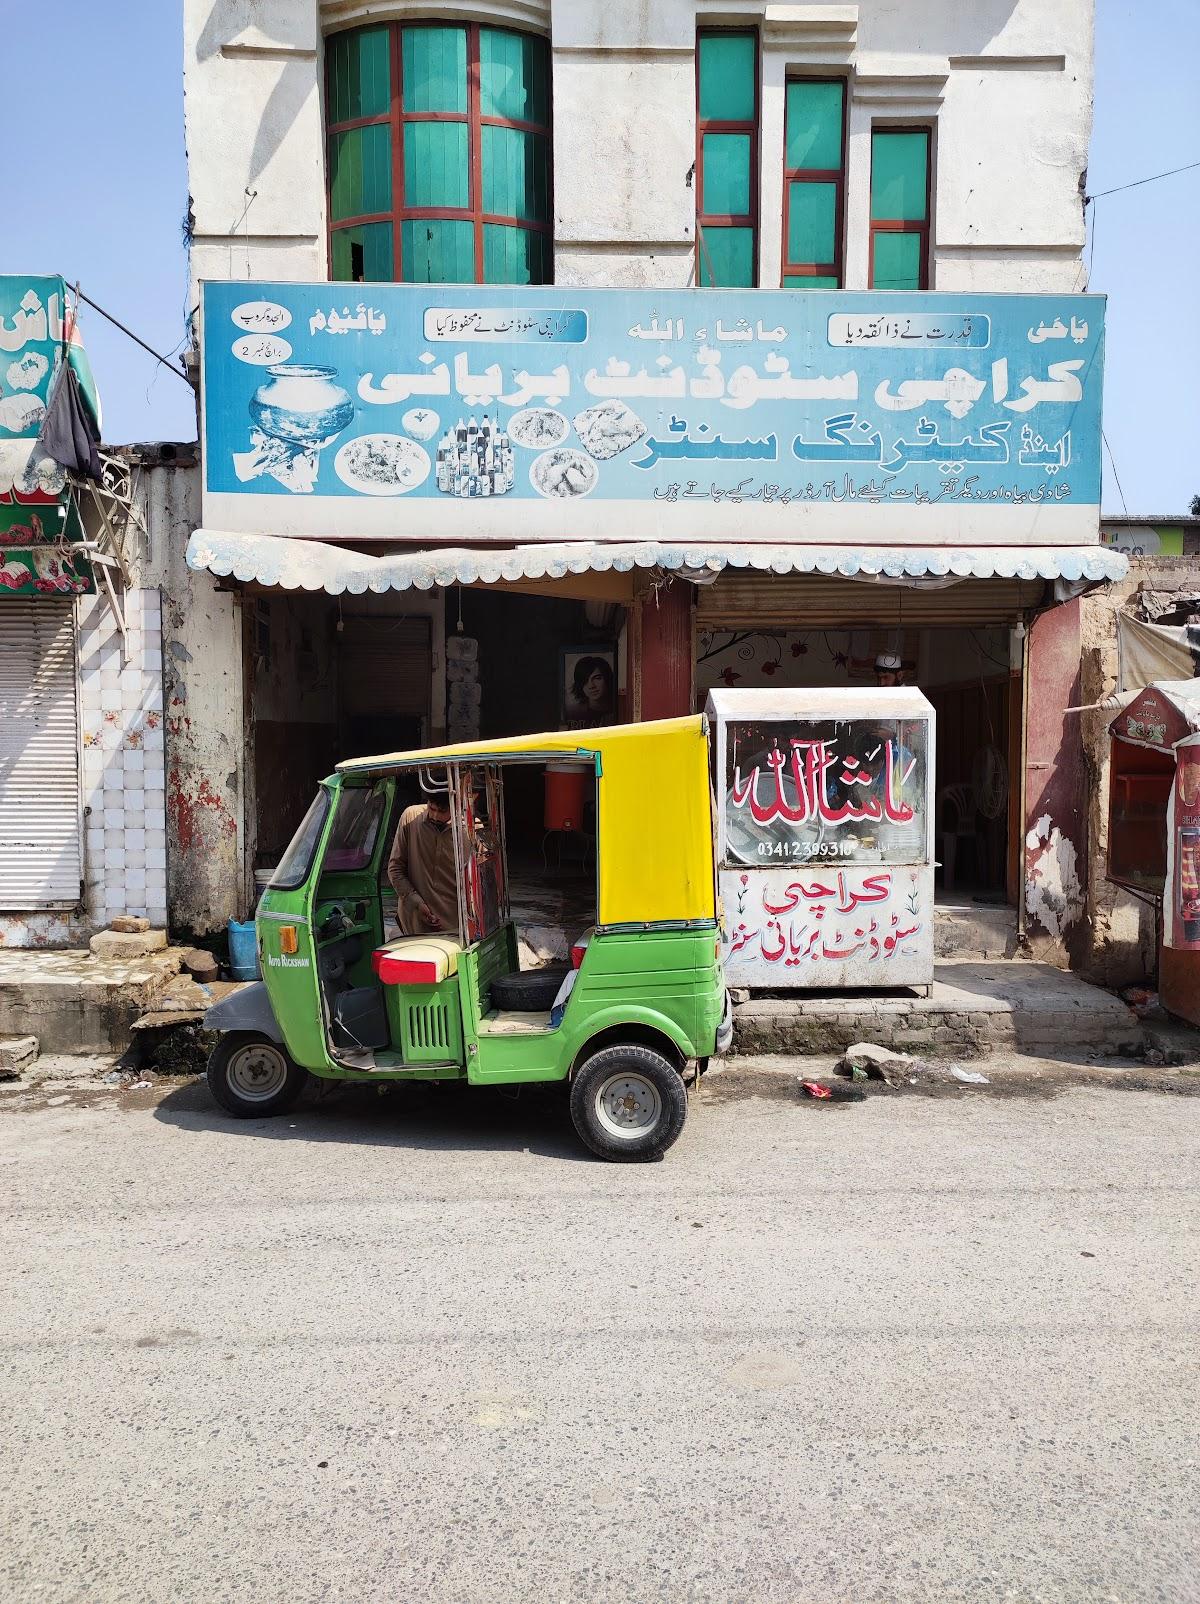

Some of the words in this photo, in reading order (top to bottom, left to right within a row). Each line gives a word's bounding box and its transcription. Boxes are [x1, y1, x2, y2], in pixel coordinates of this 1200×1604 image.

[240, 307, 272, 325] گروپ
[436, 313, 453, 336] کیا
[449, 313, 478, 332] محفوظ
[474, 316, 491, 332] نے
[494, 317, 539, 332] سٹوڈنٹ
[538, 312, 576, 339] کراچی
[845, 322, 862, 344] دیا
[900, 319, 923, 339] نے
[926, 317, 973, 341] قدرت
[242, 346, 249, 356] 2
[251, 342, 265, 358] نمبر
[264, 342, 282, 358] برانچ
[357, 351, 570, 407] بریانی
[584, 343, 858, 410] سٹوڈنٹ
[874, 357, 1086, 419] کراچی
[628, 414, 778, 471] سنٹر
[791, 411, 1012, 475] کیٹرنگ
[1018, 422, 1071, 476] اینڈ
[653, 482, 681, 503] ہیں
[682, 480, 726, 503] جاتے
[751, 483, 779, 503] تیار
[777, 487, 792, 505] پر
[793, 480, 835, 499] آرڈر
[831, 472, 858, 503] مال
[889, 477, 960, 505] تقریبات
[951, 476, 983, 500] دیگر
[982, 485, 1005, 500] اور
[1004, 483, 1028, 504] بیاہ
[1030, 482, 1071, 502] شادی
[762, 871, 892, 919] کراچی
[723, 923, 761, 965] سنٹر
[760, 920, 821, 967] بریانی
[822, 911, 921, 962] سٹوڈنٹ
